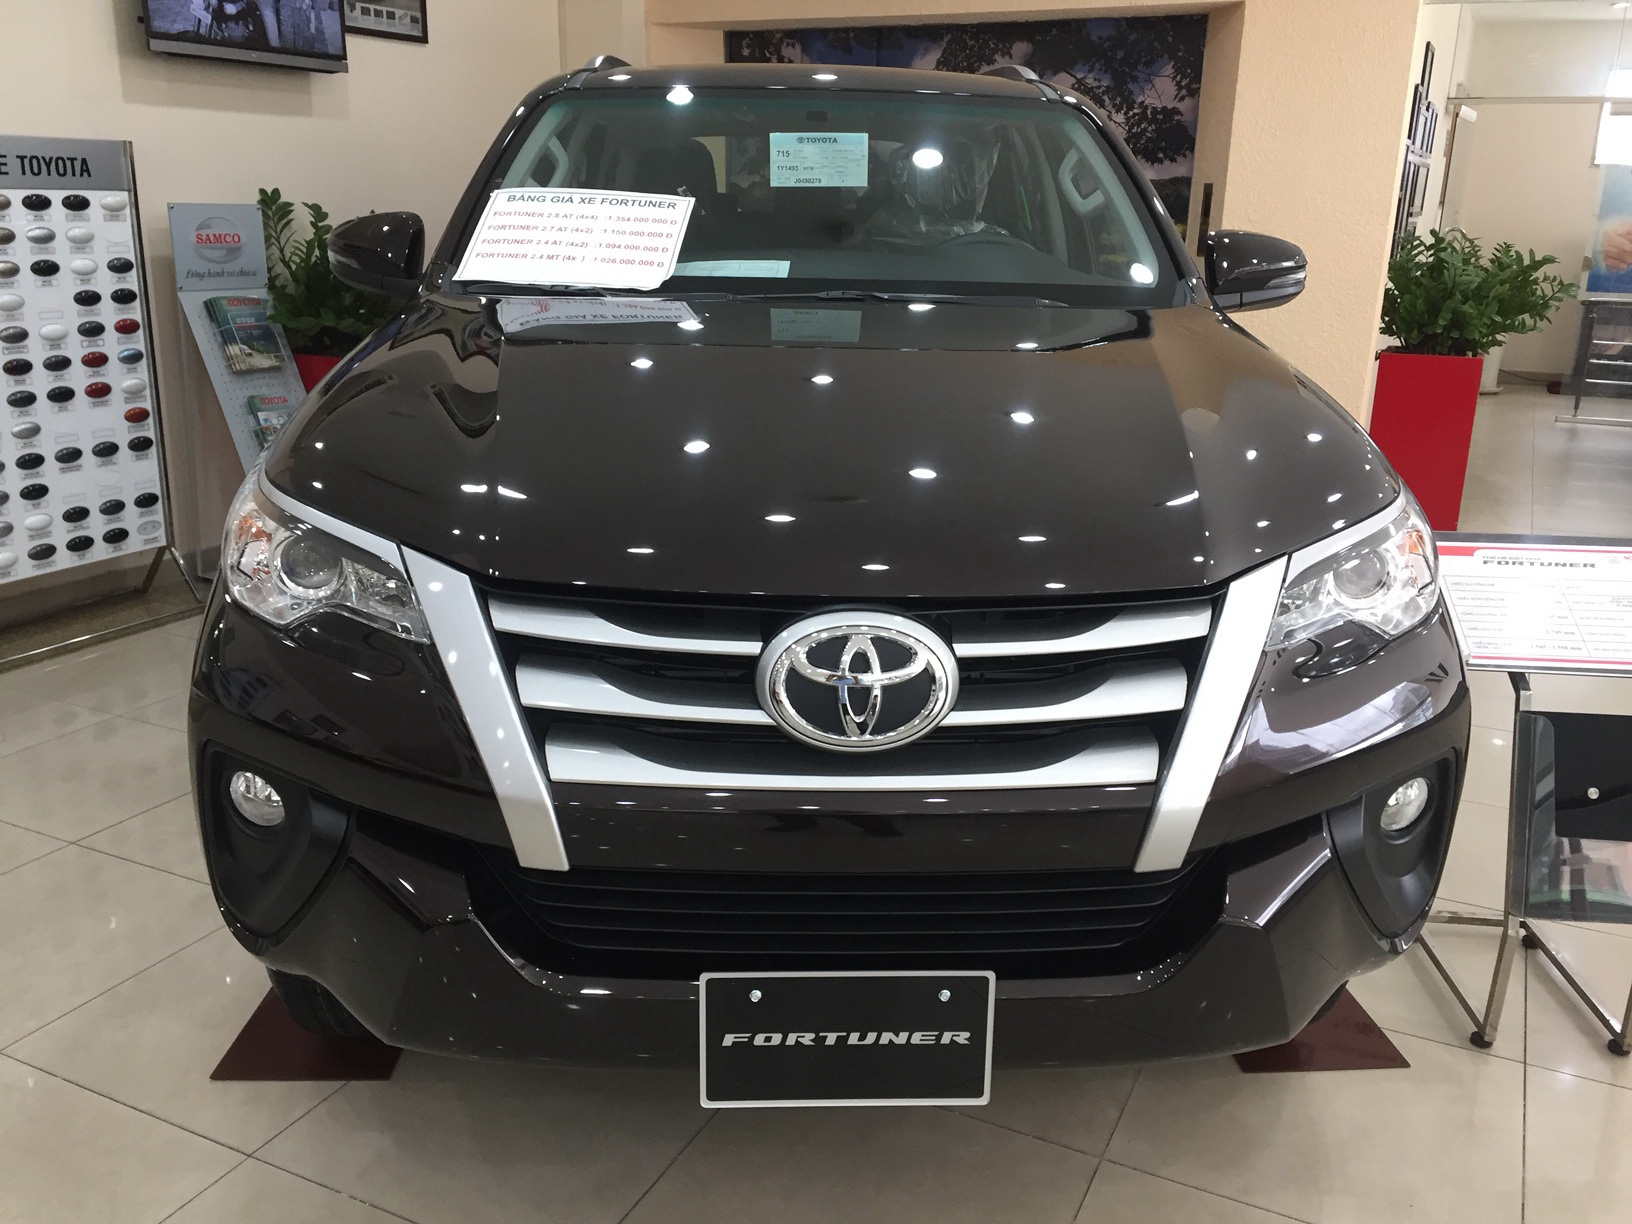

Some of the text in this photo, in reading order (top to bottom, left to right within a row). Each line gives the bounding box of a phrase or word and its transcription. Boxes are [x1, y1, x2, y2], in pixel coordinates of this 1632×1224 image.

[16, 155, 91, 177] TOYOTA
[550, 195, 574, 204] GIÁ
[600, 198, 677, 209] FORTUNER
[196, 234, 240, 244] SAMCO
[259, 396, 288, 406] TOYOTA
[1482, 560, 1596, 568] FORTUNER
[722, 1032, 970, 1046] FORTUNER
